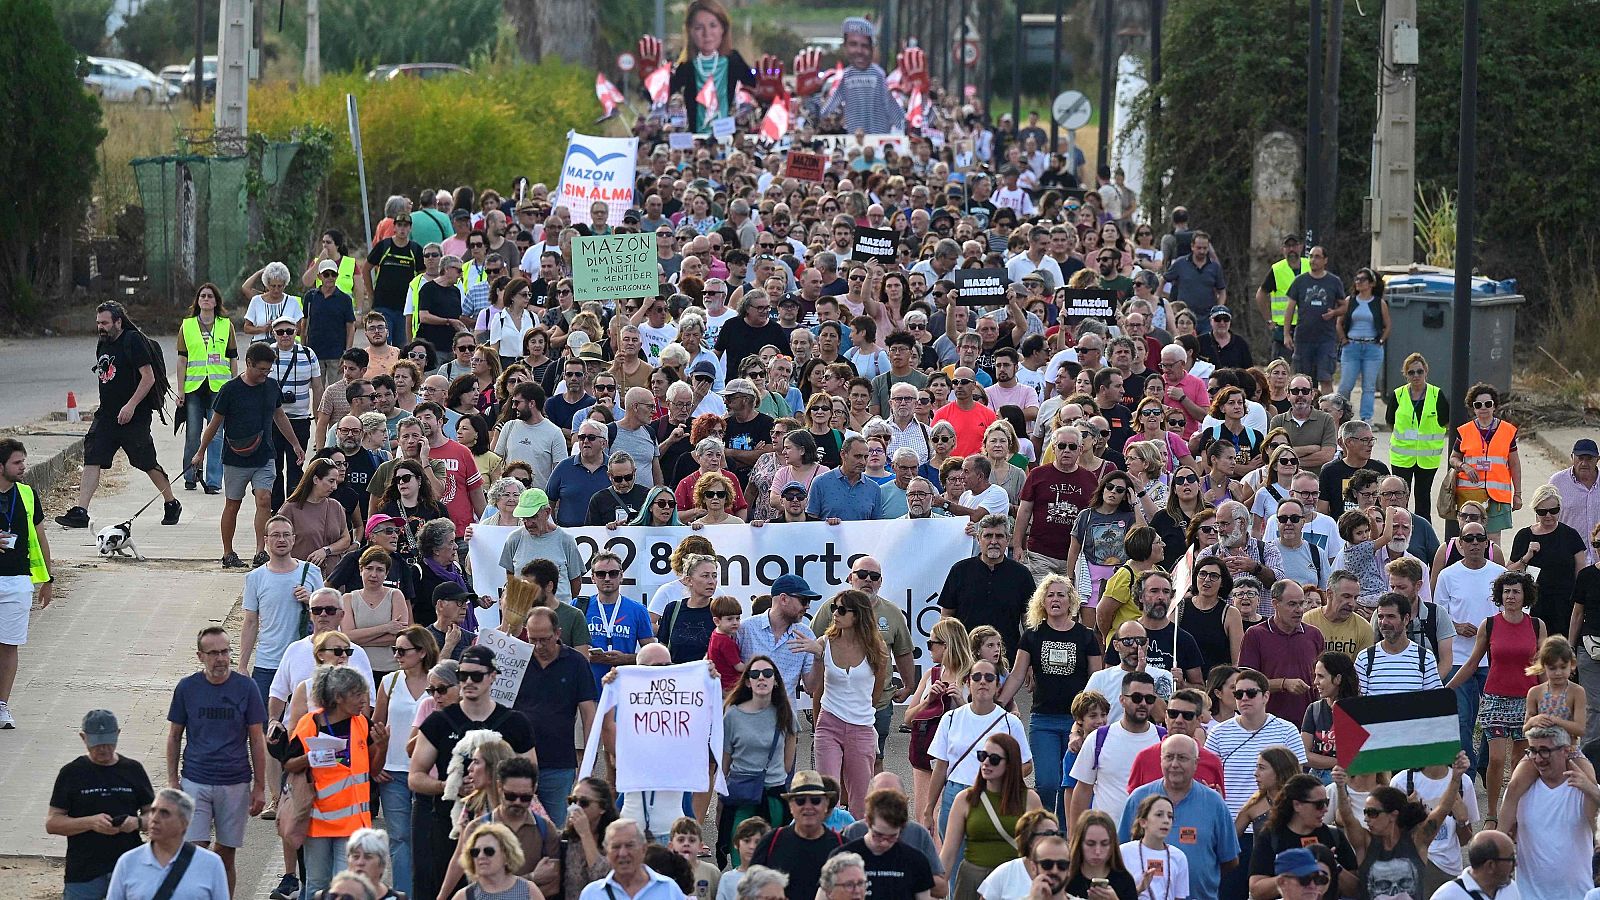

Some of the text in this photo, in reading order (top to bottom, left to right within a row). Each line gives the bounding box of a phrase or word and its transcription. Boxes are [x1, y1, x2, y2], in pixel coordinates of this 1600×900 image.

[566, 166, 615, 181] MAZON
[860, 235, 892, 248] MAZÓN
[855, 243, 894, 256] DIMISSIÓ
[604, 271, 653, 282] MENTIDER
[963, 276, 1000, 288] MAZÓN
[959, 284, 1005, 297] DIMISSIÓ
[1072, 297, 1109, 308] MAZÓN
[1067, 306, 1113, 317] DIMISSIÓ
[650, 678, 676, 692] NOS
[629, 691, 704, 707] DEJASTEIS
[634, 710, 691, 737] MORIR
